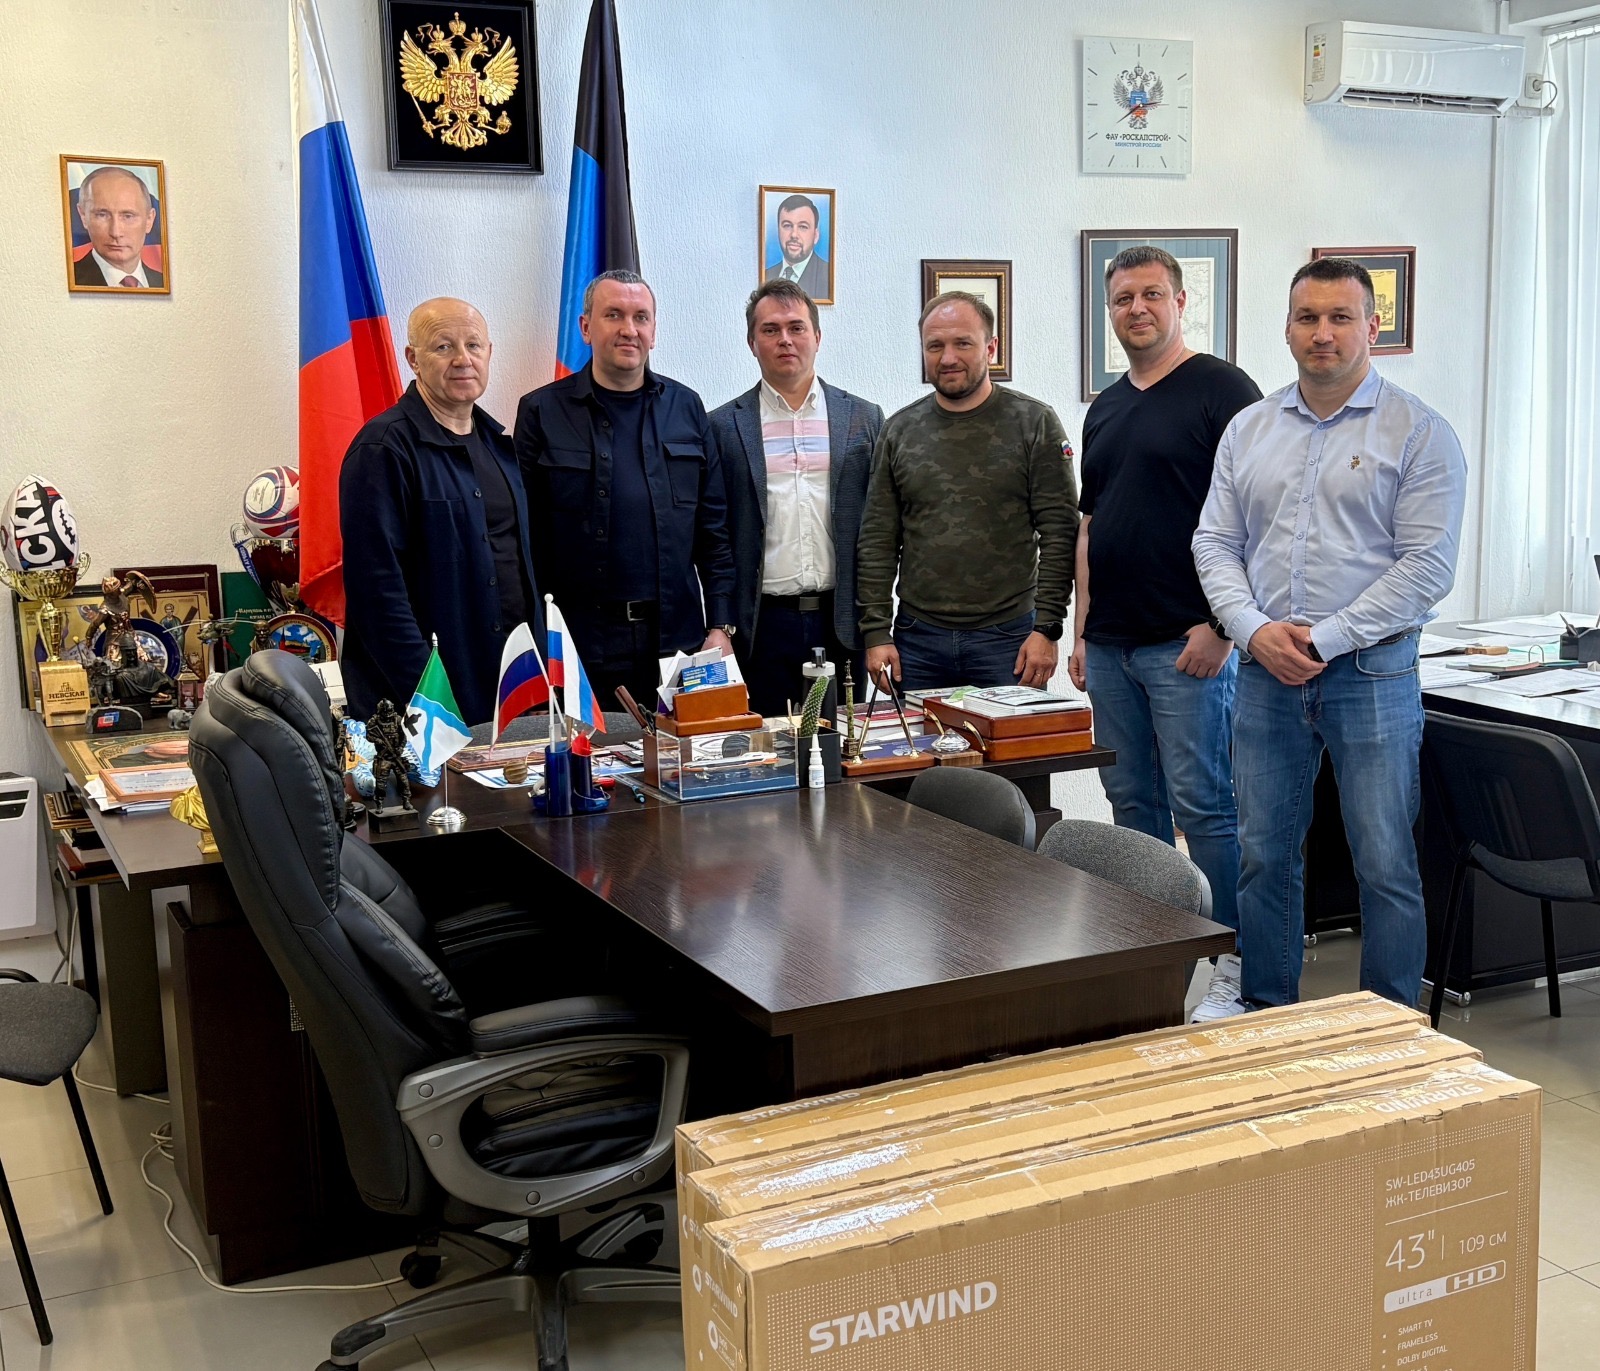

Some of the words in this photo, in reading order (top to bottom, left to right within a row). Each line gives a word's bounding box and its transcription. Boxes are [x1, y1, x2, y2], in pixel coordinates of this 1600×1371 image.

[1105, 133, 1119, 141] ФАУ
[48, 690, 86, 699] НЕВСКАЯ
[738, 1092, 861, 1123] STARWIND
[1375, 1083, 1484, 1113] STARWIND
[1385, 1158, 1476, 1191] SW-LED43UG405
[1385, 1176, 1472, 1208] ЖК-ТЕЛЕВИЗОР
[1385, 1229, 1435, 1273] 43"
[1459, 1234, 1485, 1255] 109
[705, 1270, 738, 1319] STARWIND
[1398, 1286, 1433, 1305] ultra
[1453, 1266, 1497, 1290] HD
[808, 1281, 998, 1354] STARWIND
[1398, 1321, 1422, 1336] SMART
[1424, 1319, 1433, 1328] TV
[1397, 1332, 1439, 1351] FRAMELESS
[1397, 1352, 1420, 1367] DOLBY
[1421, 1345, 1448, 1359] DIGITAL
